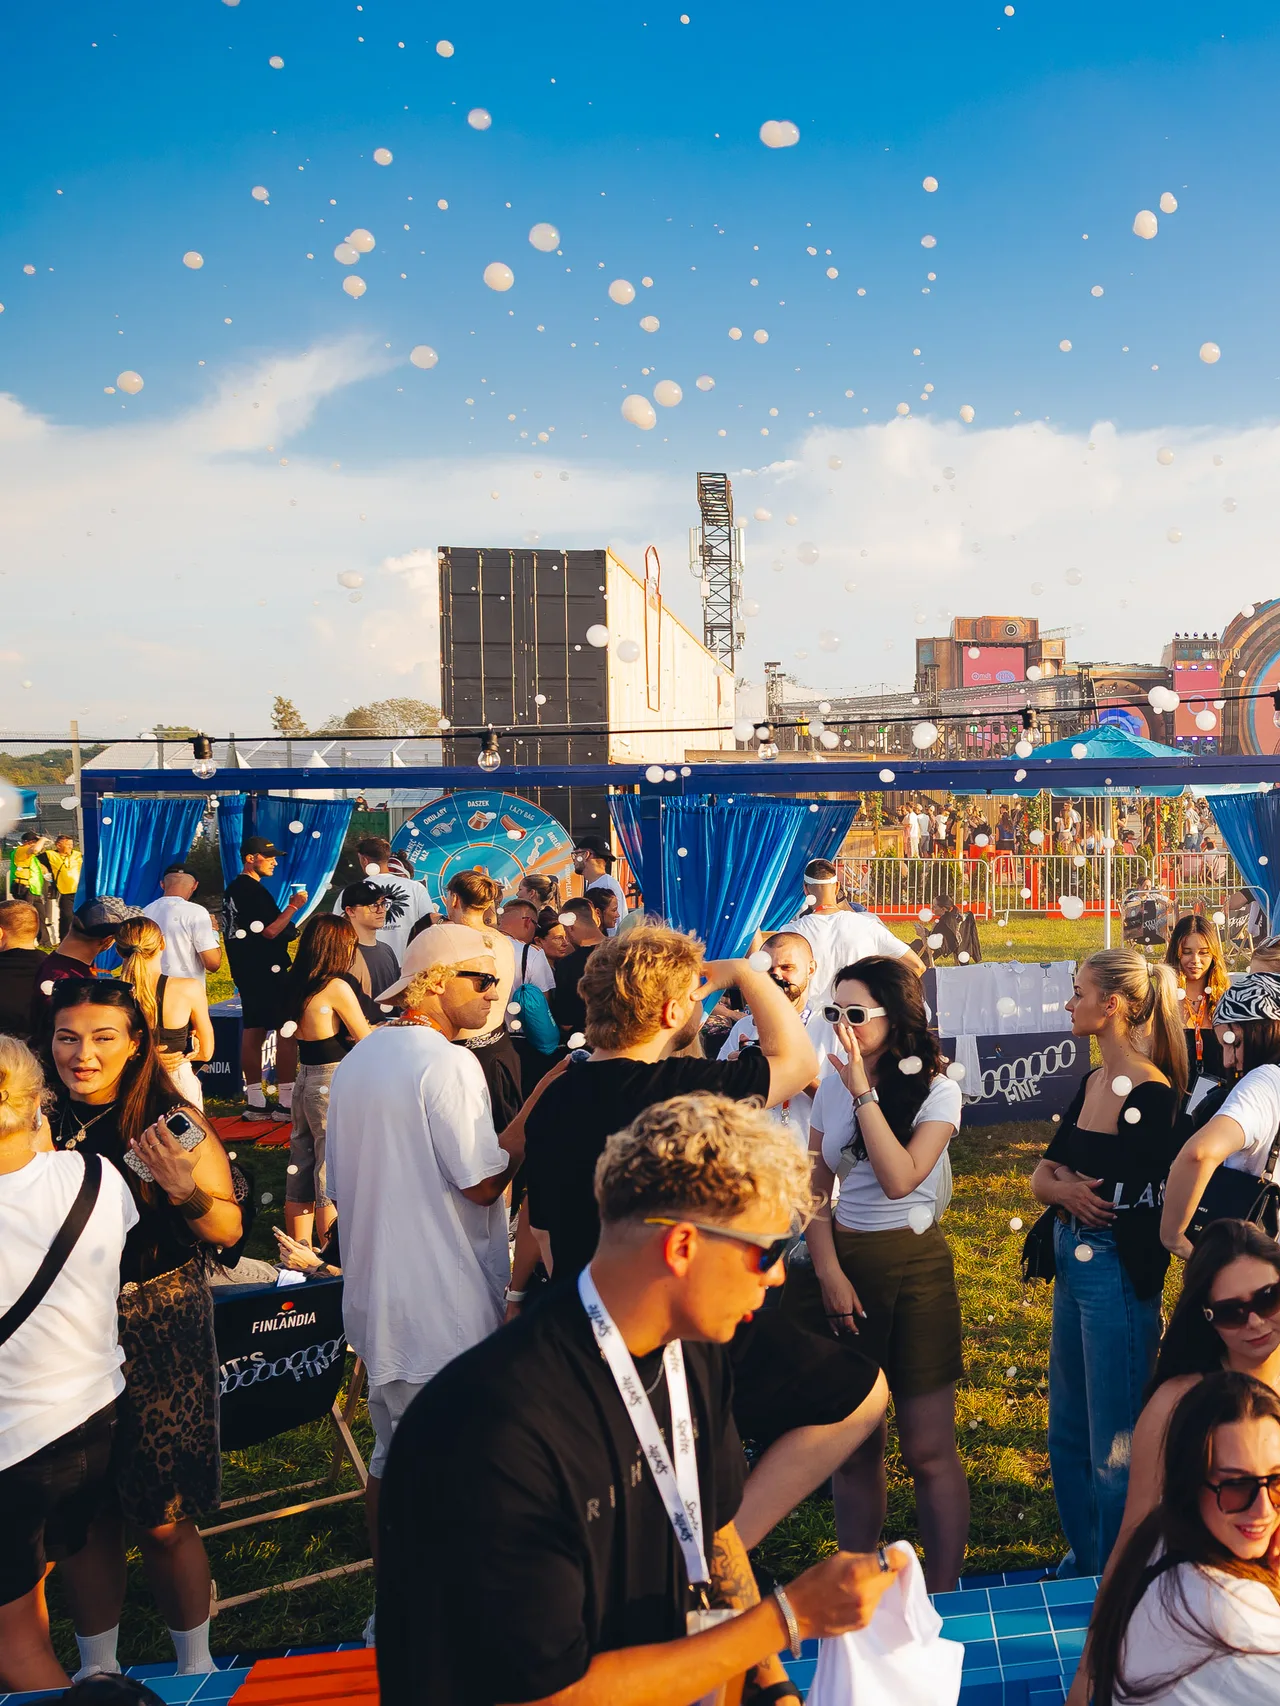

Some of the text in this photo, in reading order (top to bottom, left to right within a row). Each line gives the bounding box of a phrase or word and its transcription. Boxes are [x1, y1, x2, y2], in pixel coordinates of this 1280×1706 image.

[467, 800, 490, 808] DASZEK
[509, 804, 536, 821] LAZY BAG
[423, 807, 448, 825] OKULARY
[405, 838, 417, 860] AKRĘĆ
[546, 832, 563, 851] BRELOK
[419, 850, 430, 862] RAZ
[207, 1062, 231, 1074] NDIA
[252, 1312, 316, 1334] FINLANDIA
[588, 1304, 611, 1337] Sprite
[220, 1351, 266, 1379] IT'S
[622, 1376, 642, 1406] Sprite
[676, 1418, 689, 1455] Sprite
